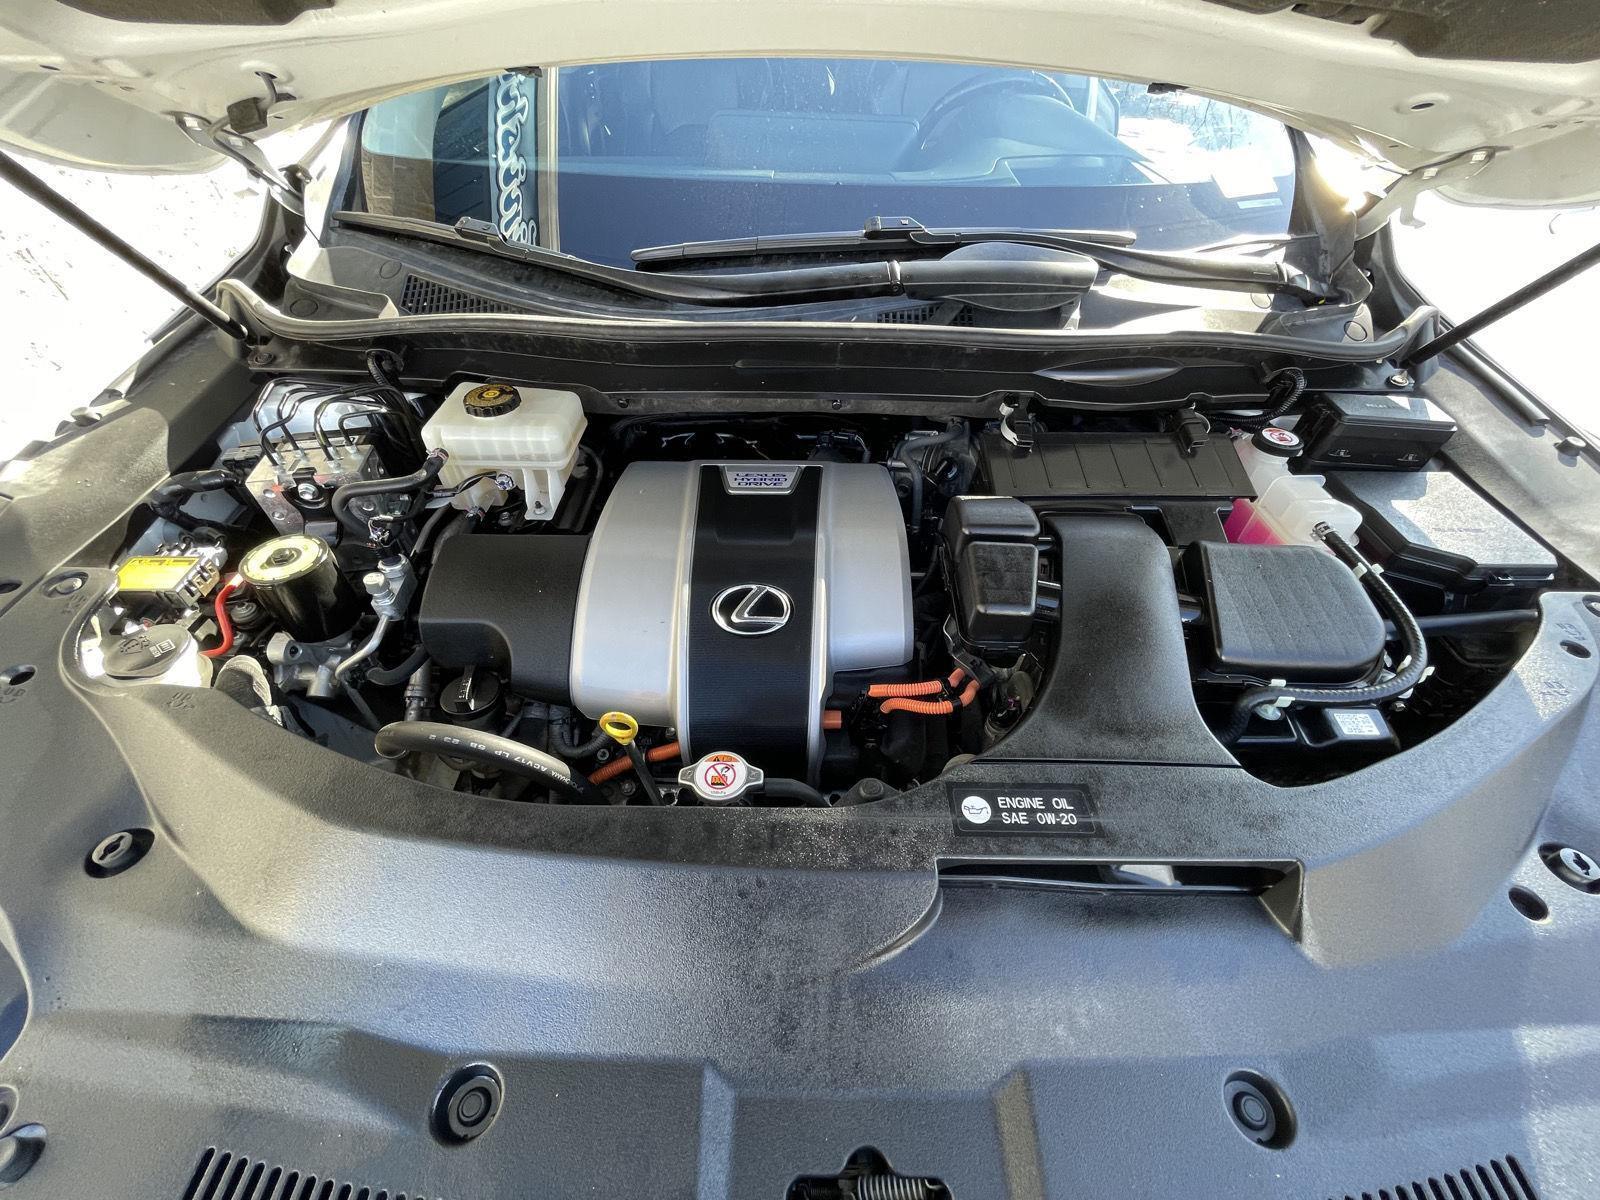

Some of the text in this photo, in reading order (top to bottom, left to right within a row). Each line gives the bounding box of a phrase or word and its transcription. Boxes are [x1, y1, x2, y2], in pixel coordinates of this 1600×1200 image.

[494, 750, 510, 758] LP
[514, 756, 548, 772] ACV17
[997, 796, 1075, 810] ENGINE OIL
[1001, 812, 1078, 825] SAE 0W-20
